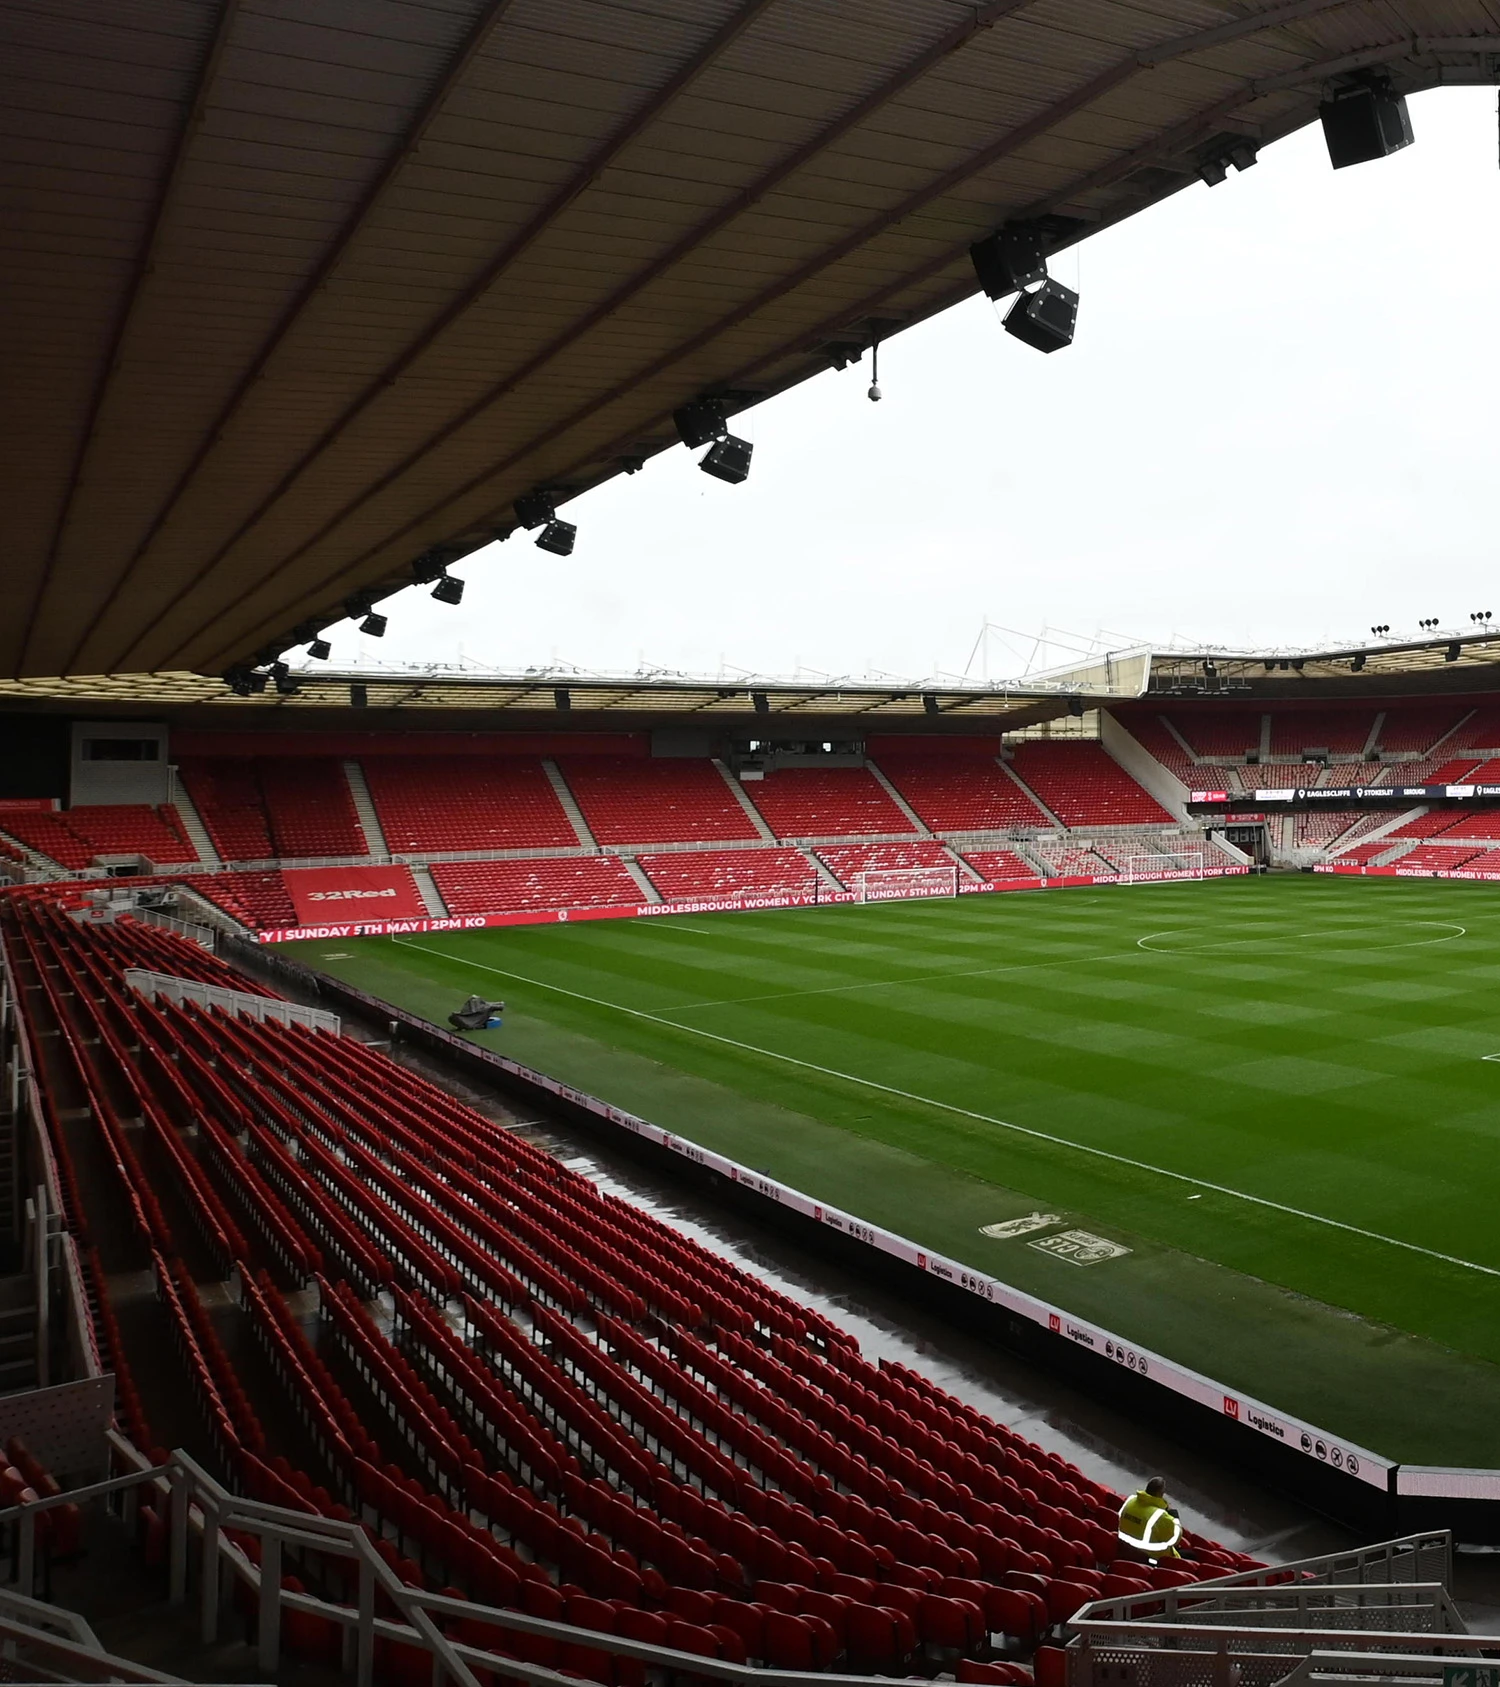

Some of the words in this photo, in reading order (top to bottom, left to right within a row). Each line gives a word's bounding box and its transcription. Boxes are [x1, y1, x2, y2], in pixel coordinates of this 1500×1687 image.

[1093, 872, 1162, 884] MIDDLESBROUGH
[1164, 870, 1195, 880] WOMEN
[1203, 867, 1223, 877] YORK
[1225, 867, 1241, 875] CITY
[1450, 870, 1476, 879] WOMEN
[1483, 872, 1500, 880] YORK
[307, 888, 397, 902] 32Red
[637, 900, 741, 916] MIDDLESBROUGH
[744, 897, 789, 909] WOMEN
[792, 896, 801, 905] V
[834, 892, 858, 902] CITY
[867, 888, 907, 900] SUNDAY
[909, 887, 928, 898] 5TH
[930, 886, 951, 897] MAY
[959, 884, 978, 893] 2PM
[980, 883, 994, 892] KO
[285, 926, 350, 940] SUNDAY
[386, 921, 419, 933] MAY
[431, 918, 461, 930] 2PM
[465, 917, 486, 927] KO
[930, 1261, 953, 1279] Logistics
[1066, 1324, 1094, 1346] Logistics
[1247, 1410, 1285, 1438] Logistics
